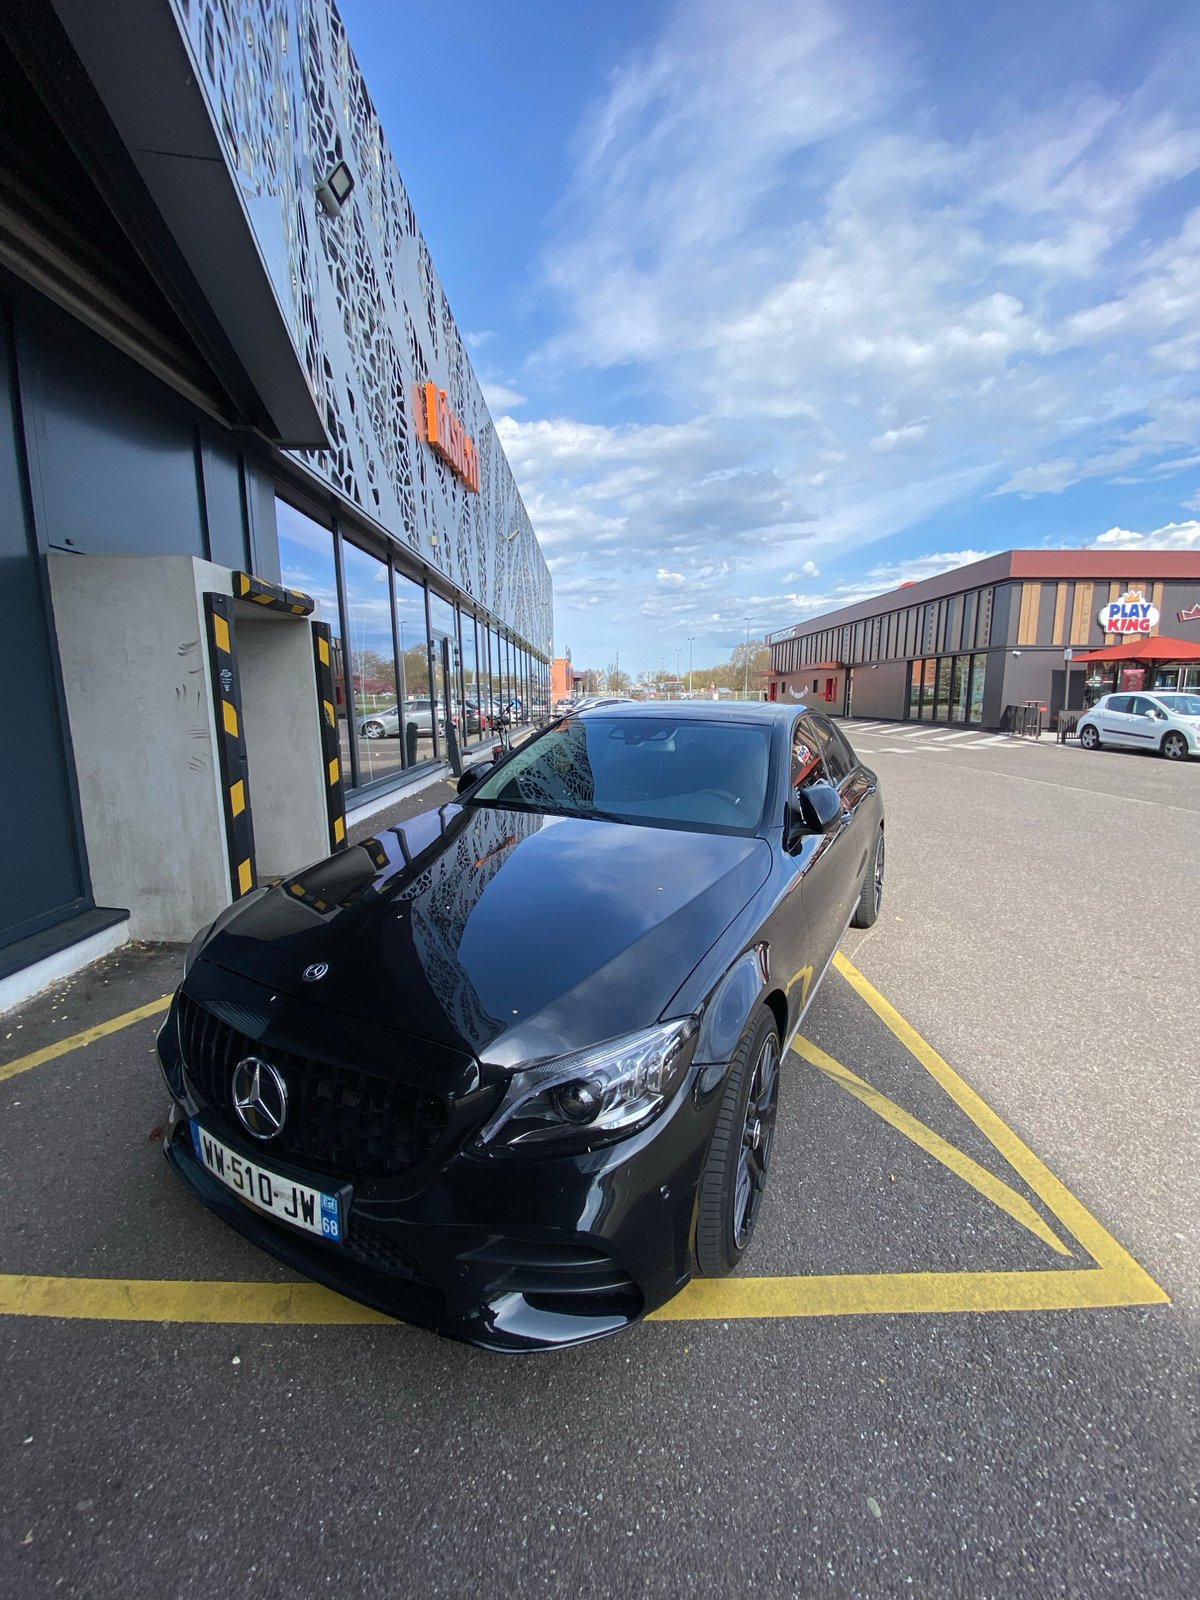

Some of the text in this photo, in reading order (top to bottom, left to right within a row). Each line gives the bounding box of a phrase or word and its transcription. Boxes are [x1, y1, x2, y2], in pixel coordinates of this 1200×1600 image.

[1109, 604, 1152, 618] PLAY
[1107, 619, 1150, 631] KING
[322, 1217, 339, 1236] 68
